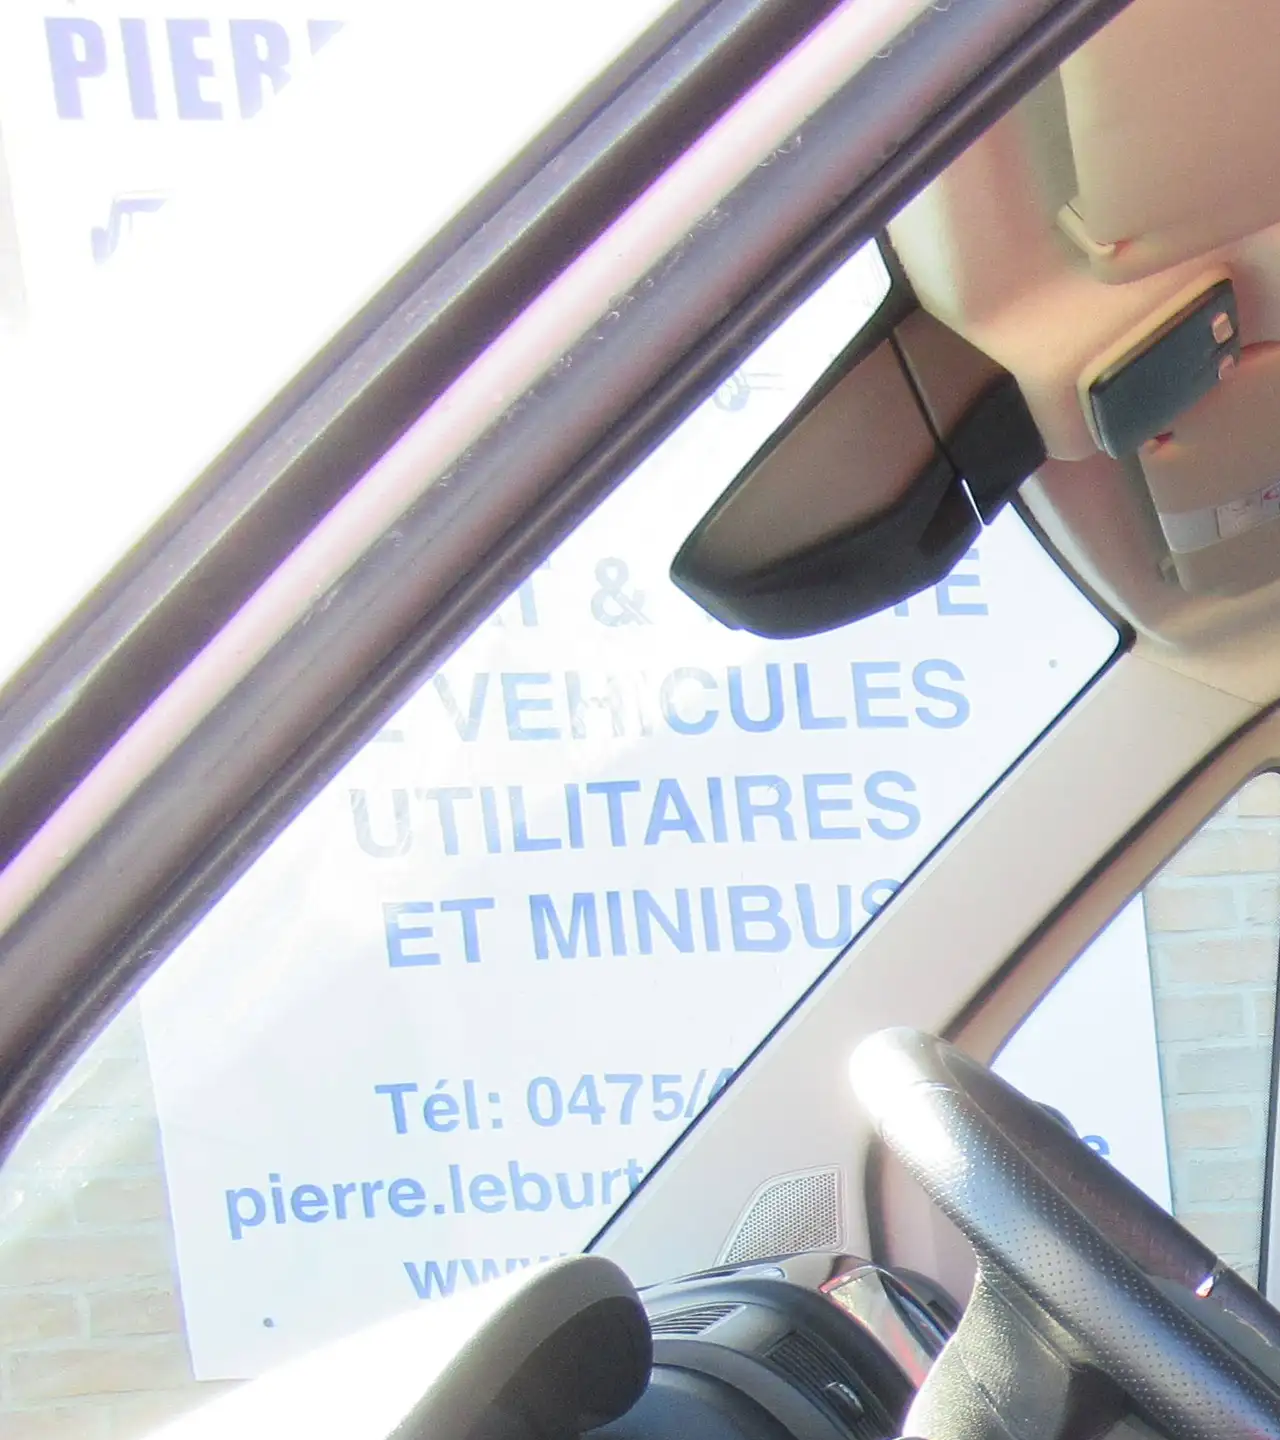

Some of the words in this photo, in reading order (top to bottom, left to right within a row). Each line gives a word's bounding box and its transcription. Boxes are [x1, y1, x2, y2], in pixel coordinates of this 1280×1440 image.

[44, 16, 348, 121] PIER
[589, 555, 652, 628] &
[347, 768, 923, 860] UTILITAIRES
[381, 896, 496, 969] ET
[375, 1078, 504, 1135] Tél:
[225, 1158, 644, 1240] pierre.leburt
